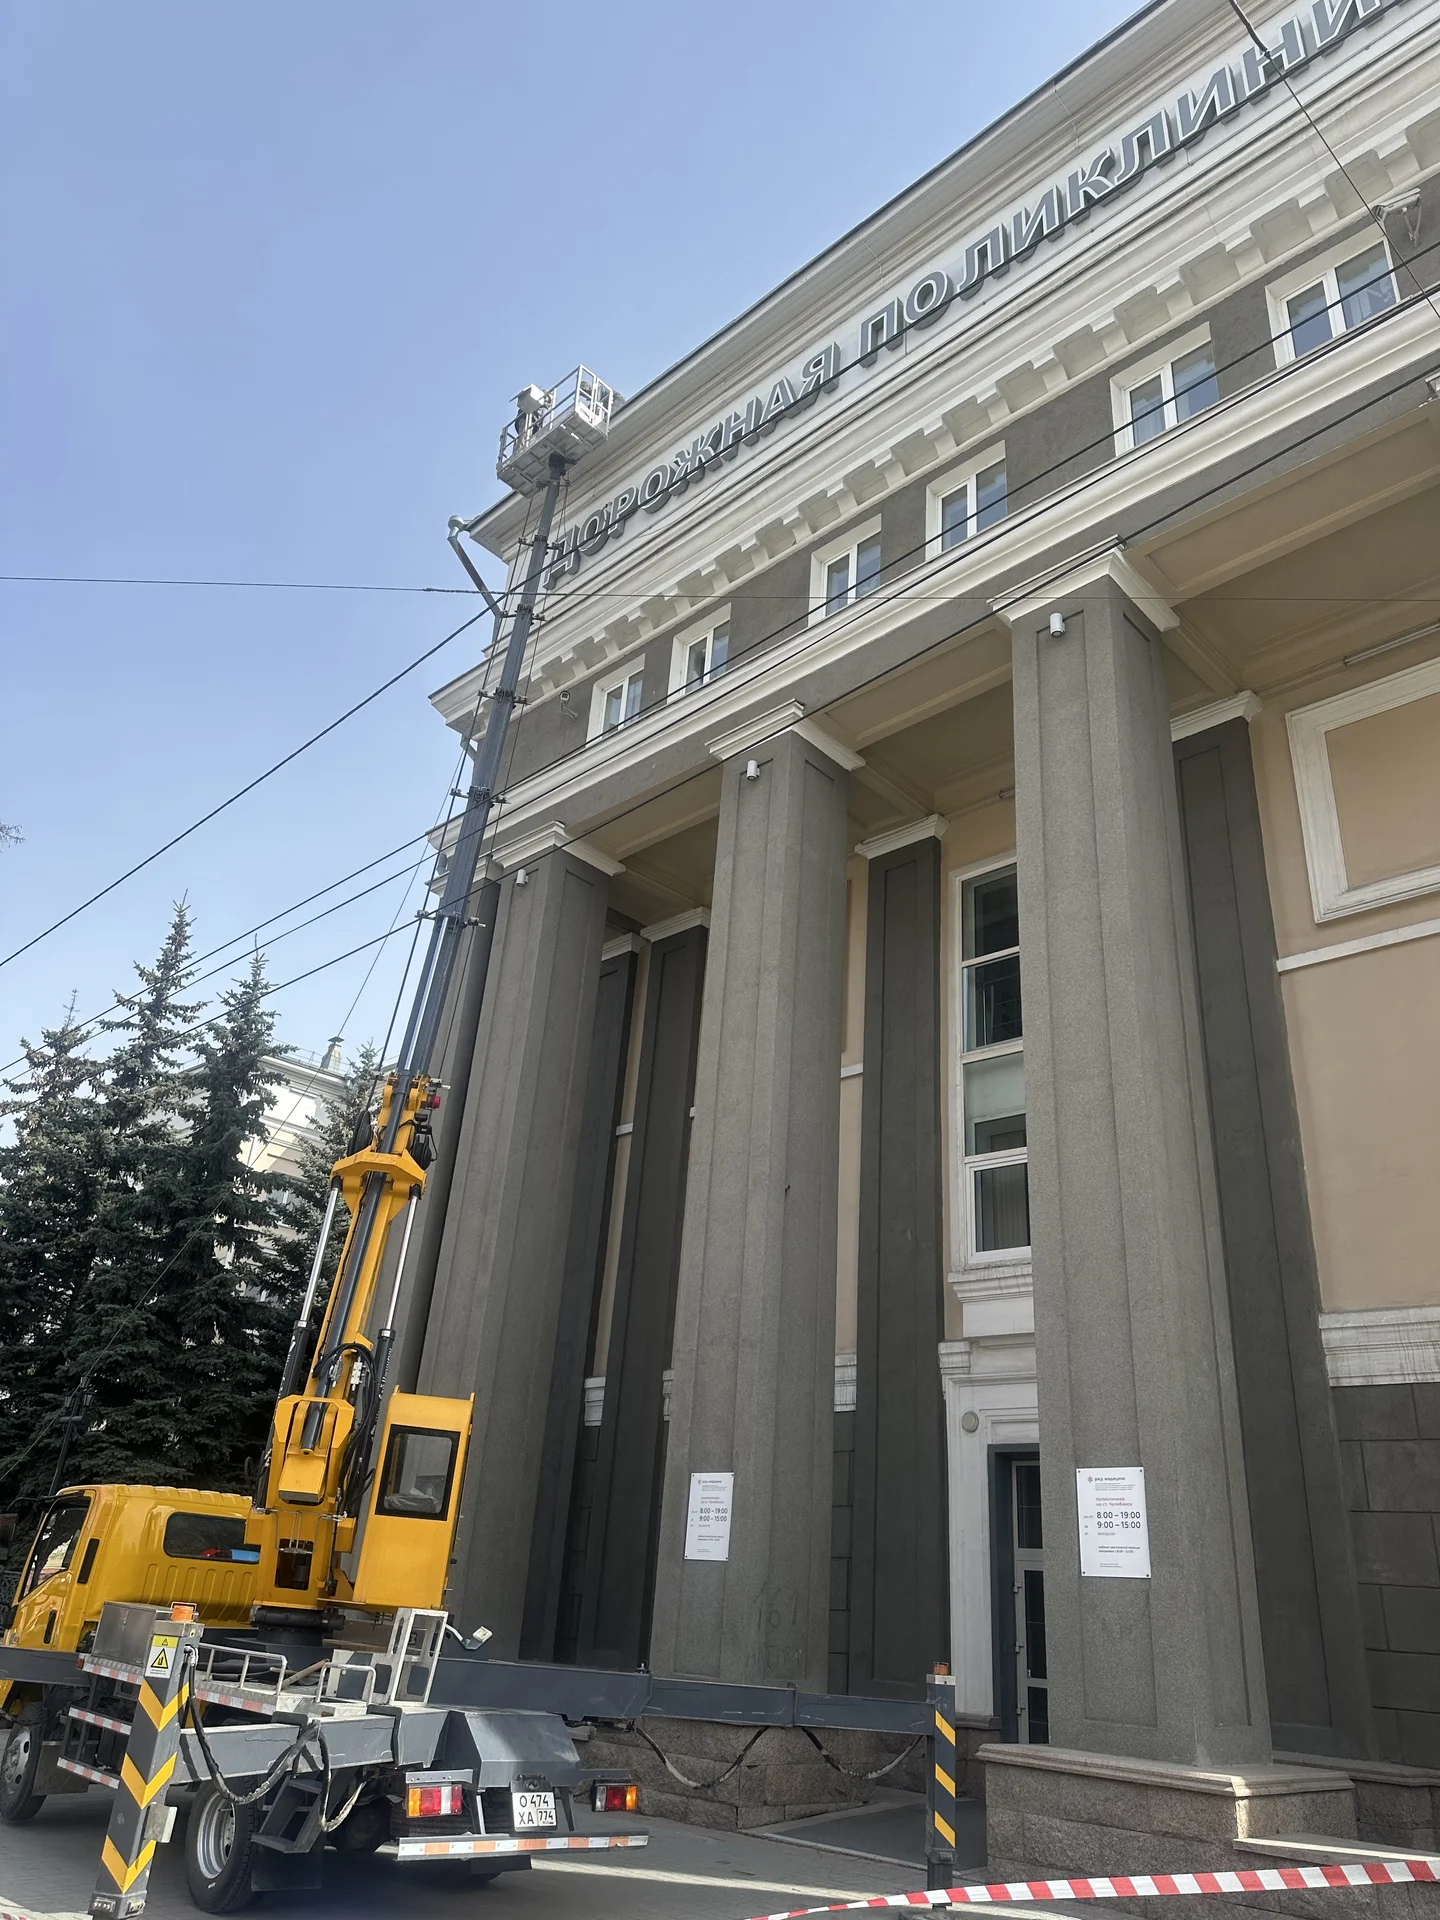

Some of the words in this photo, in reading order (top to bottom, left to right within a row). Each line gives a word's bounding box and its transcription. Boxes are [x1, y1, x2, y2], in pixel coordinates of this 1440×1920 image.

[543, 341, 841, 590] ДОРОЖНАЯ
[1096, 1511, 1113, 1519] 8:00
[1120, 1511, 1141, 1519] 19:00
[1097, 1521, 1114, 1529] 9:00
[1121, 1521, 1141, 1529] 15:00
[530, 1794, 549, 1807] 474
[538, 1810, 554, 1821] 774
